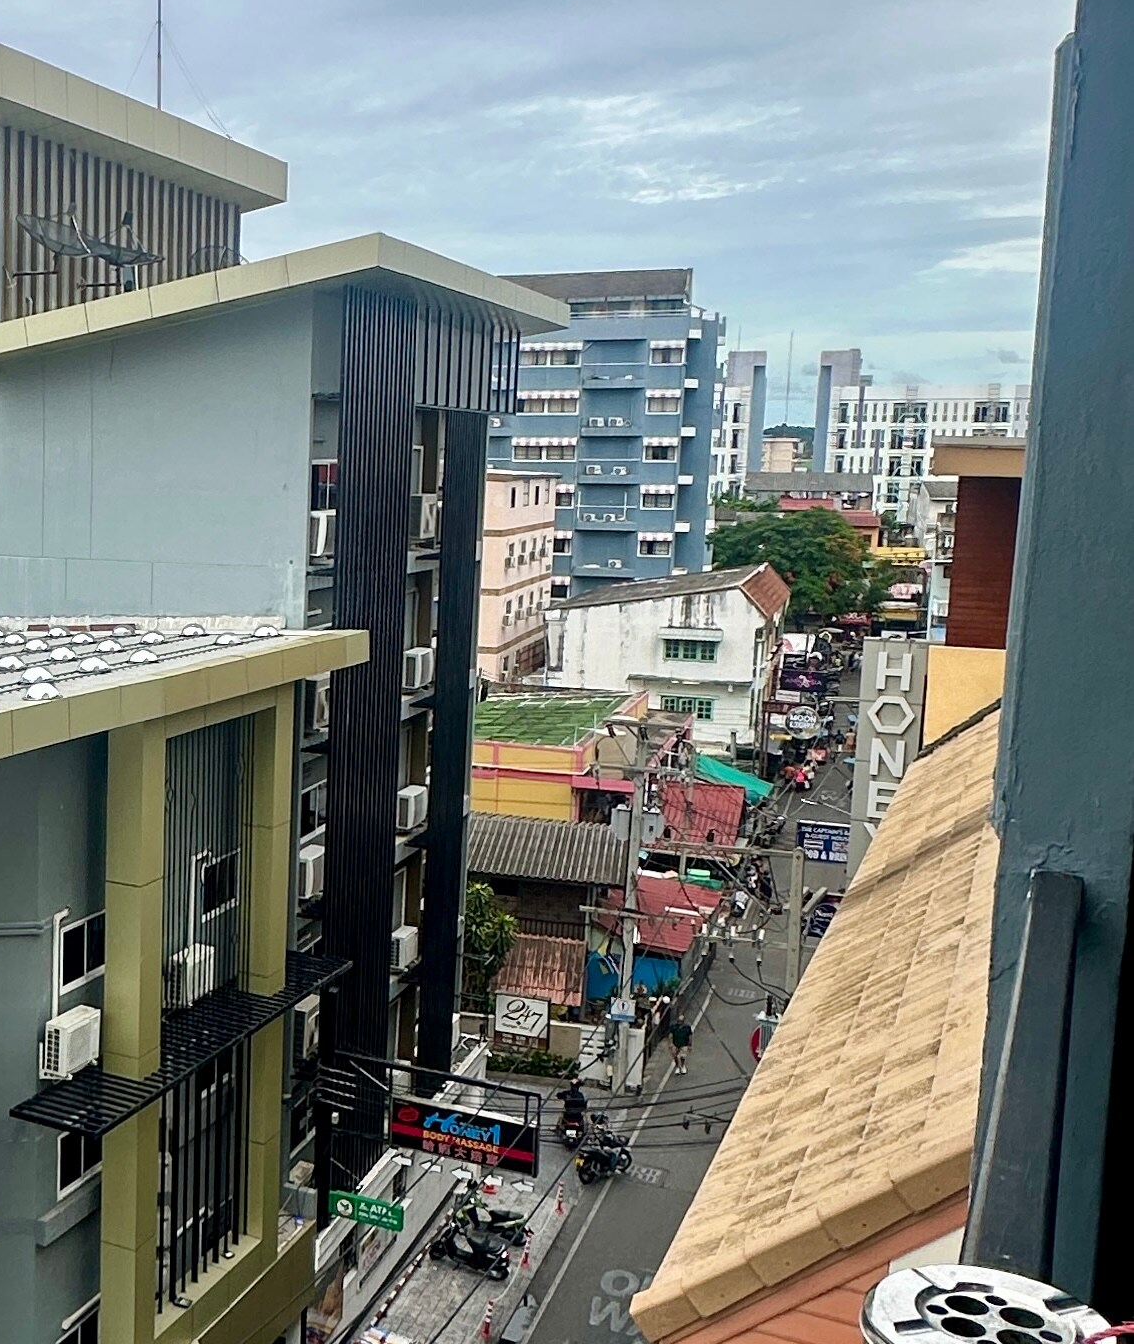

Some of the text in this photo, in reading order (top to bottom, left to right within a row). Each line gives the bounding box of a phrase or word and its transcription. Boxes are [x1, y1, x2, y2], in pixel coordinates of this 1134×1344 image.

[790, 714, 817, 723] MOON
[423, 1129, 500, 1154] BODY MASSAGE
[600, 1268, 656, 1298] O
[589, 1296, 642, 1337] W
